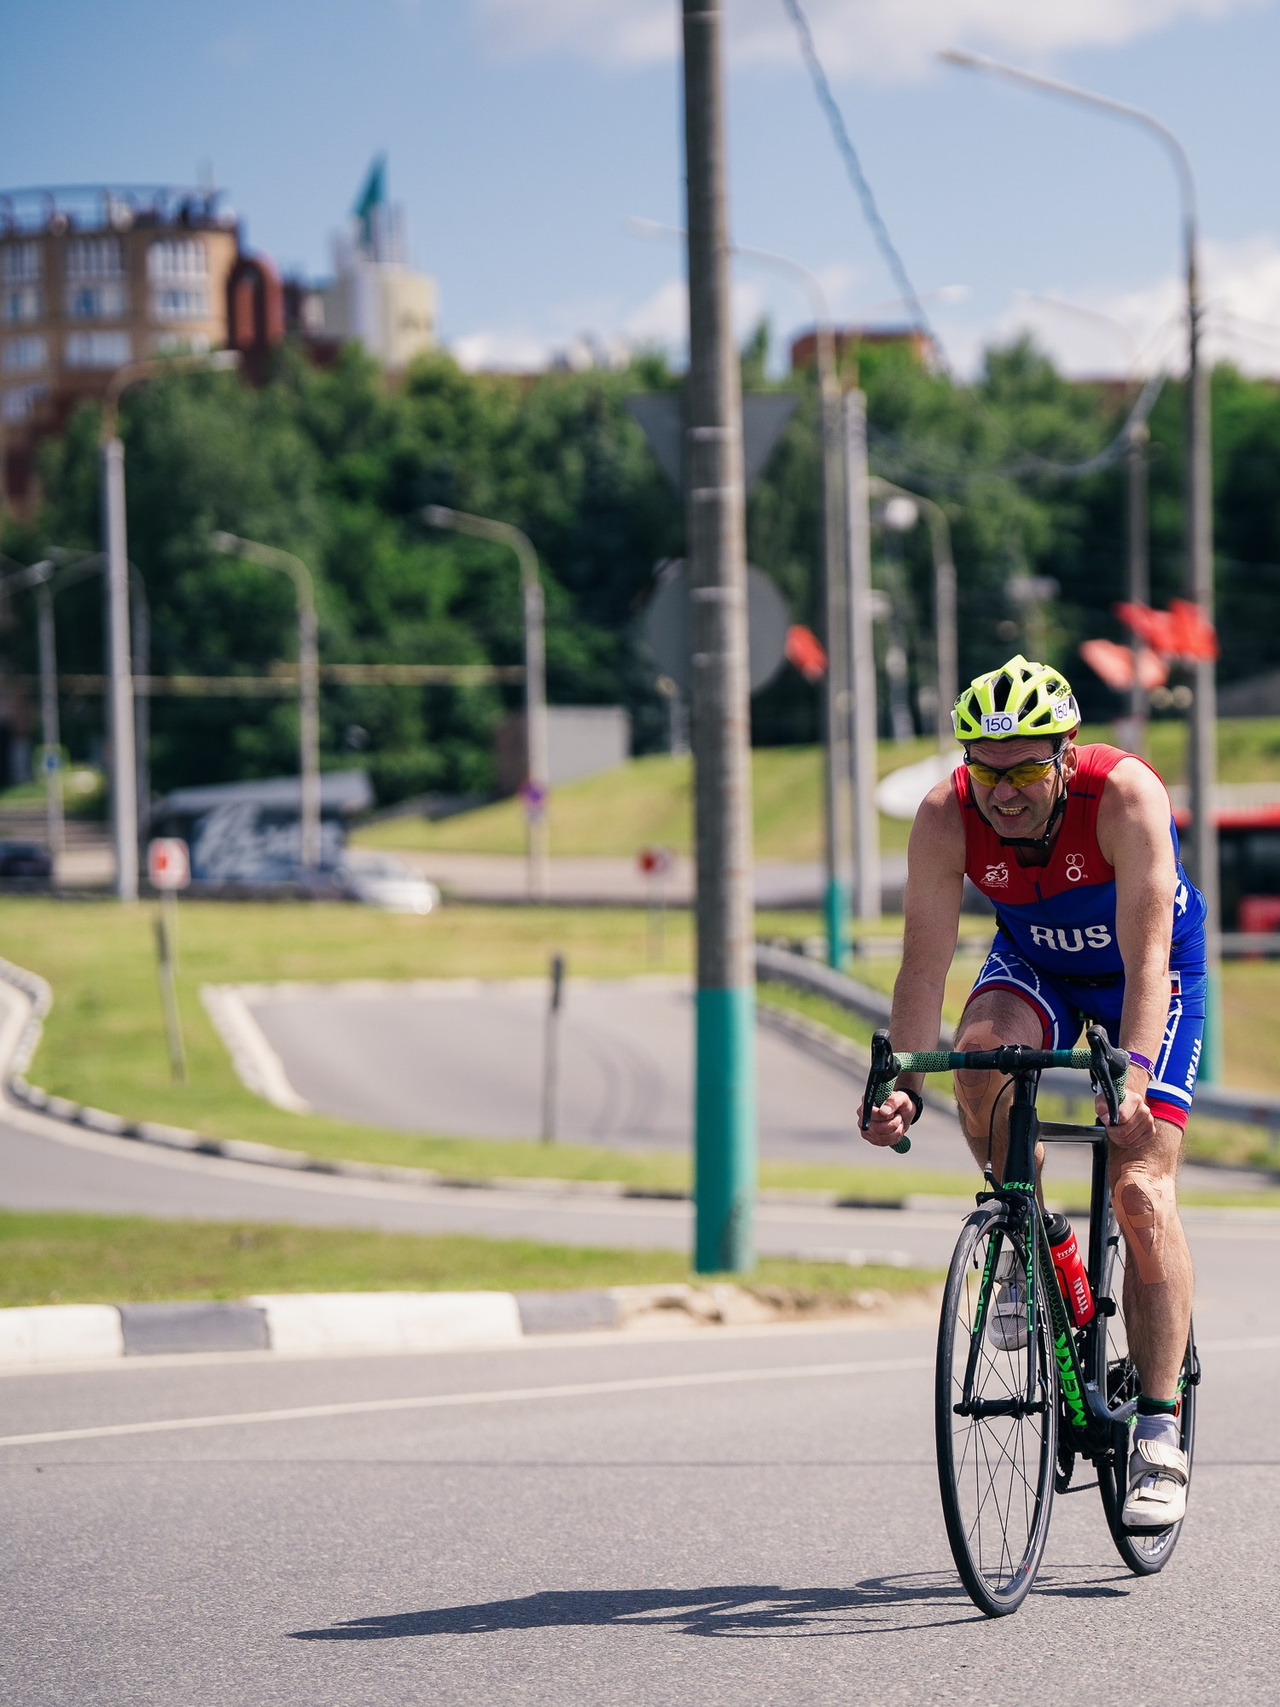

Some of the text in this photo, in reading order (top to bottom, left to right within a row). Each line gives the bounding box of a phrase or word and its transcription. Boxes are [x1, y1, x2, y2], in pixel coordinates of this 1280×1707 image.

[985, 716, 1012, 732] 150
[1054, 702, 1068, 719] 150
[1030, 925, 1112, 952] RUS
[1184, 1038, 1202, 1091] TITAN
[1056, 1242, 1076, 1260] TITAN
[1073, 1276, 1089, 1315] TITAN
[1054, 1331, 1088, 1426] MEKK
